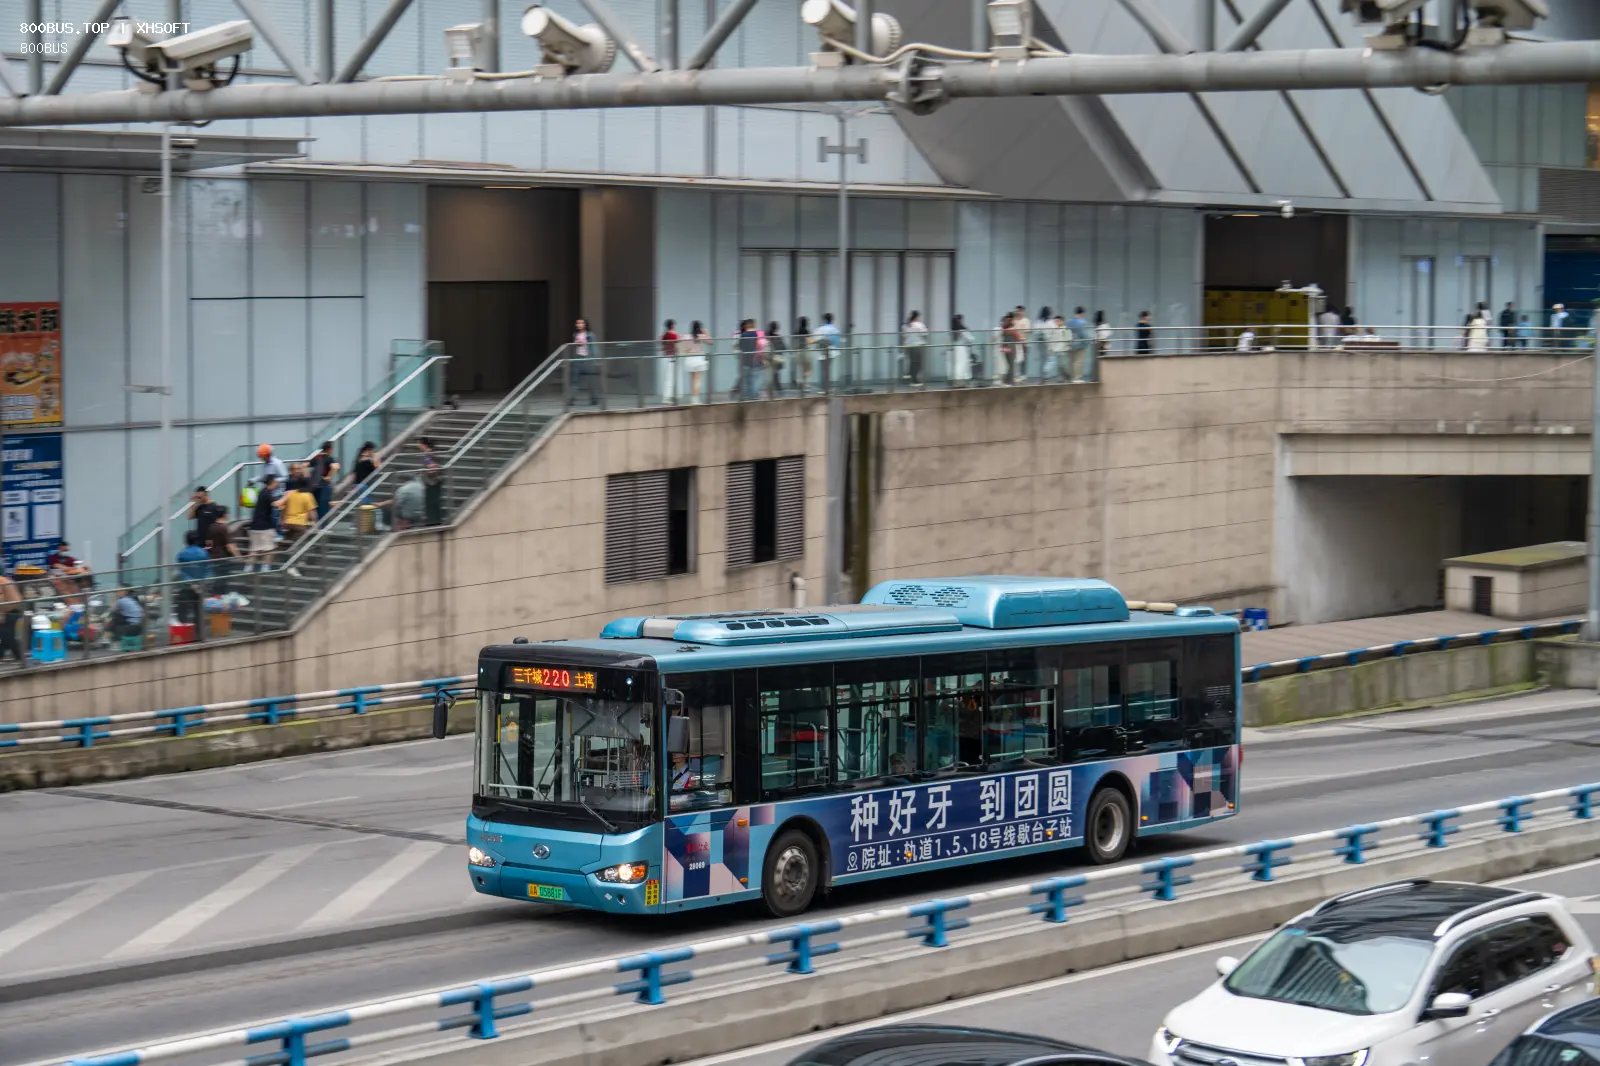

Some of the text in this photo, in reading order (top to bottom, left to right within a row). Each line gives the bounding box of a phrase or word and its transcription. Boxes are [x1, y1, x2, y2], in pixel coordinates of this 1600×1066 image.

[543, 669, 569, 687] 220
[850, 770, 1071, 841] 种好牙 到团圆
